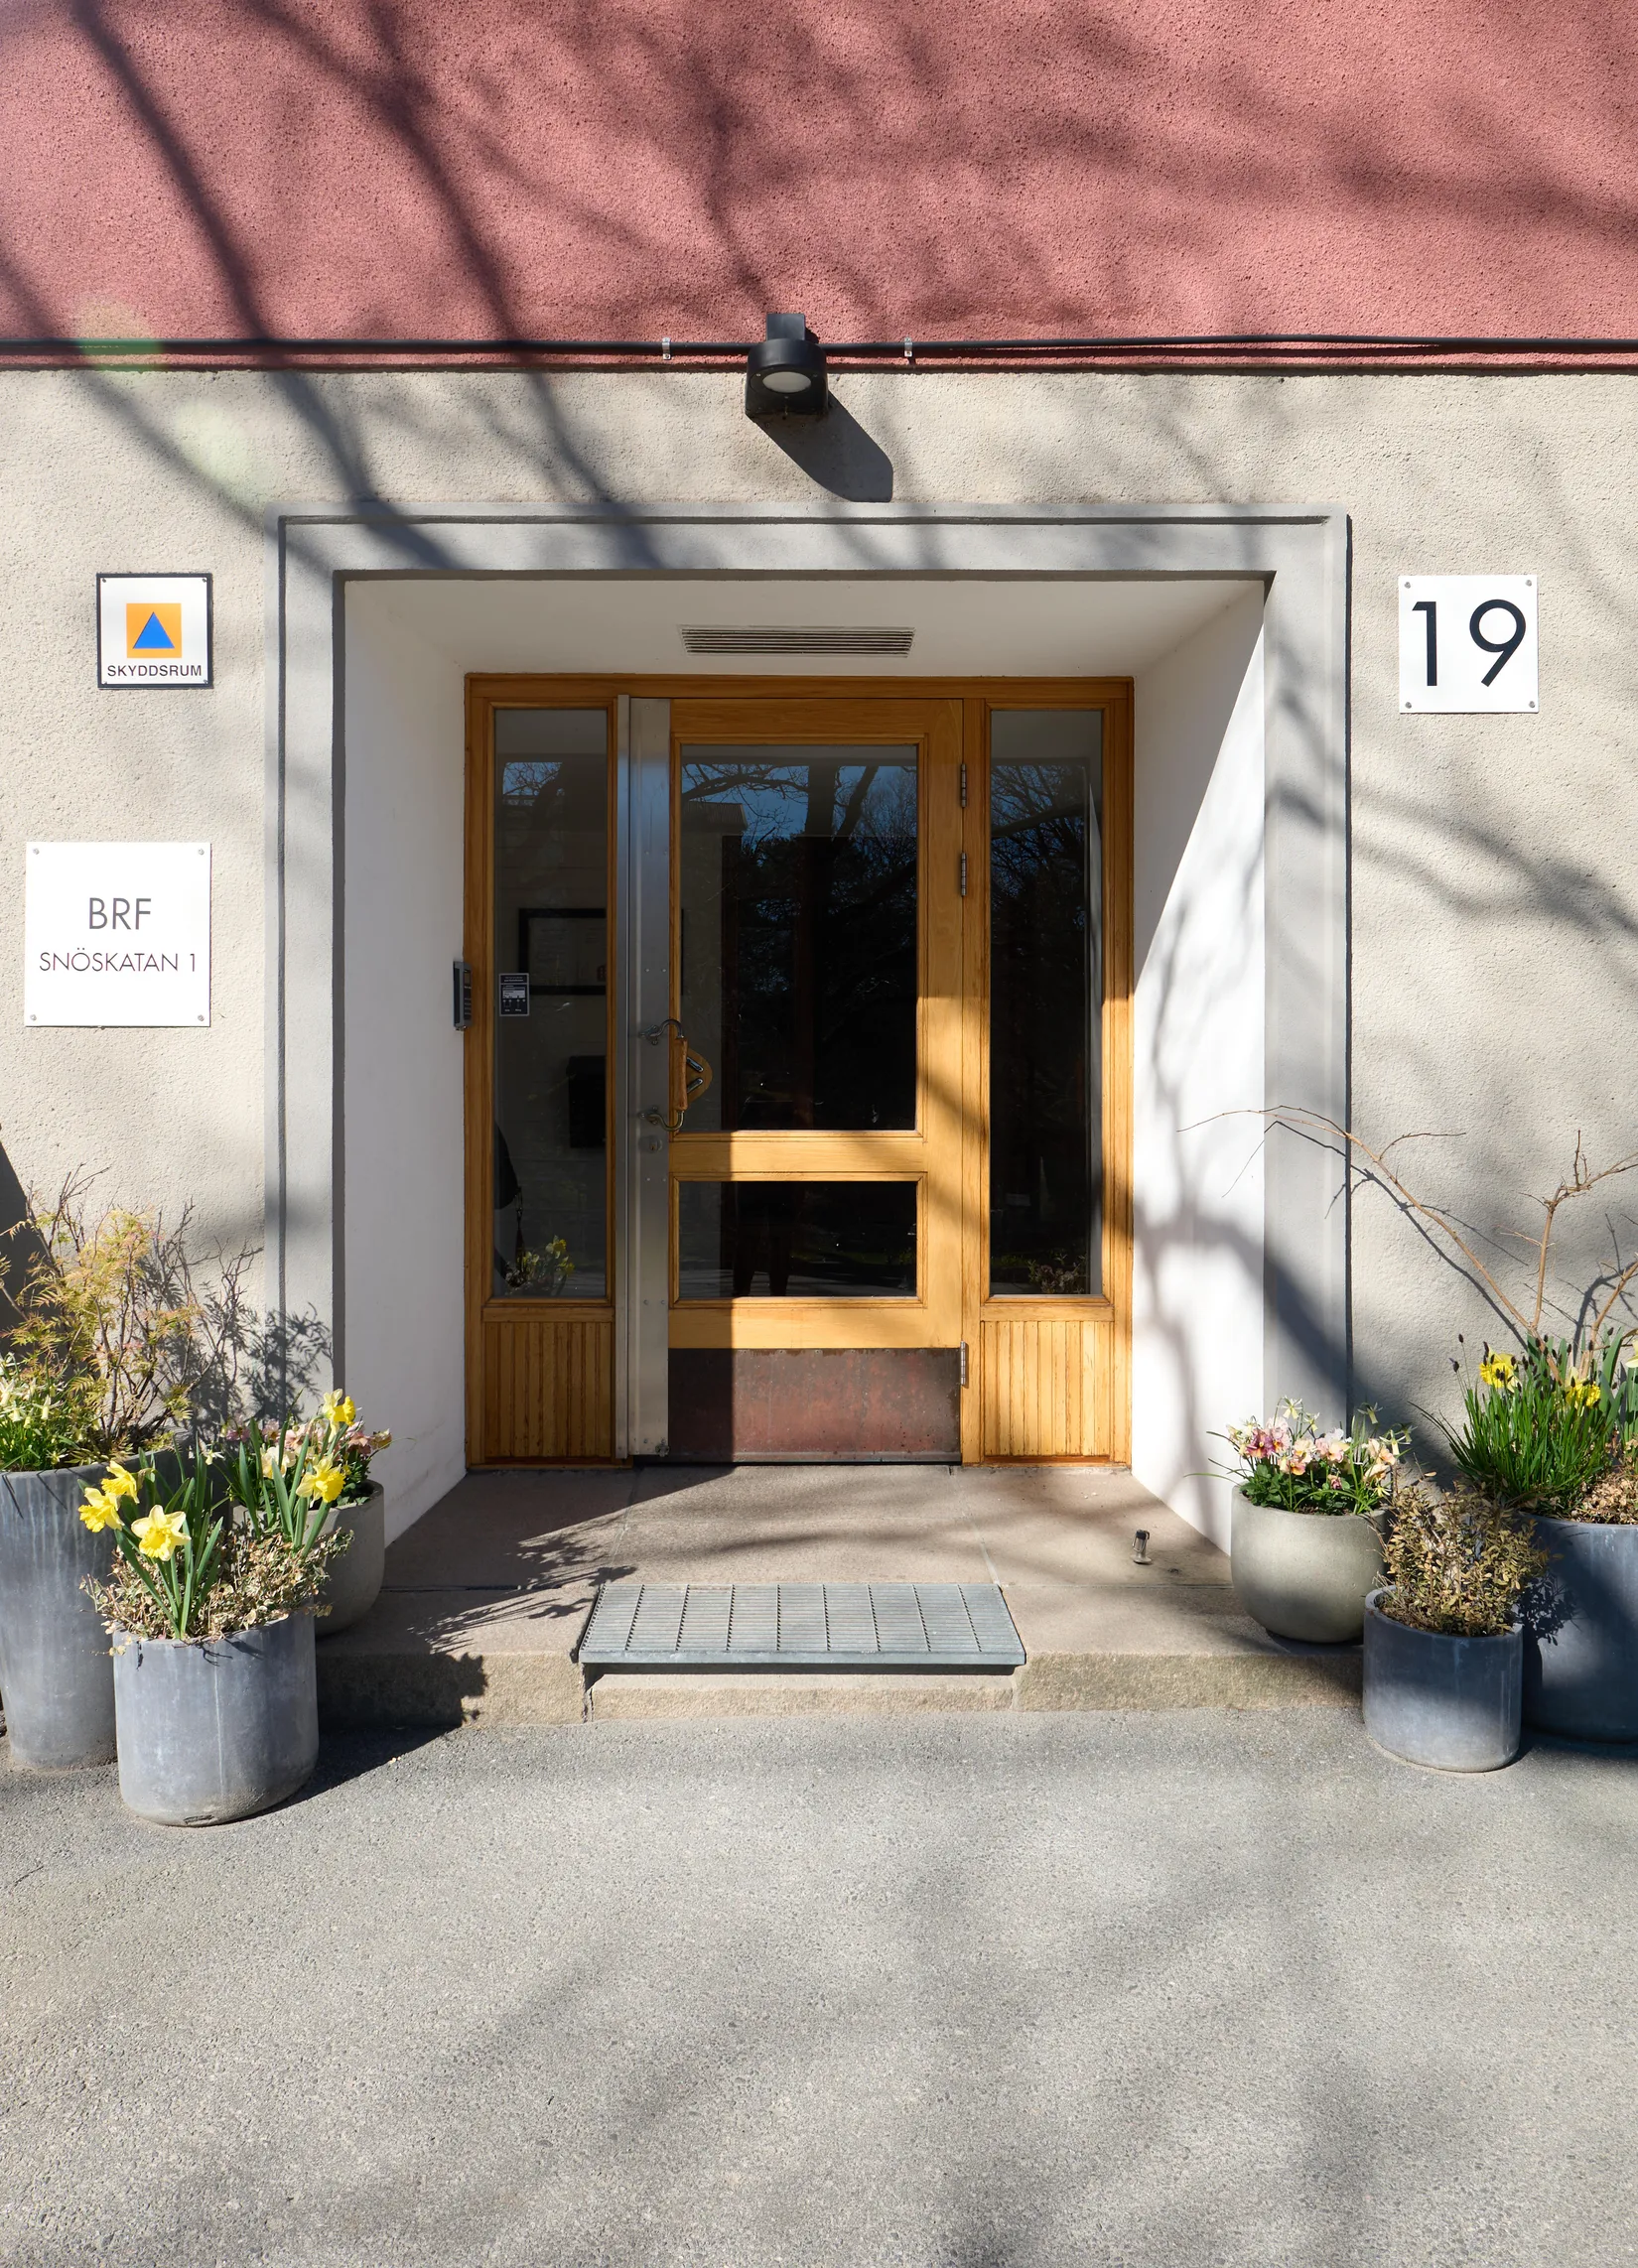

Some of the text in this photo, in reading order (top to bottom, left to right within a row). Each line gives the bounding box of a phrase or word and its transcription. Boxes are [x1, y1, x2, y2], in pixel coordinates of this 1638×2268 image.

[1412, 599, 1527, 688] 19
[107, 664, 203, 677] SKYDDSRUM
[88, 897, 152, 930] BRF
[39, 947, 196, 972] SNÖSKATAN 1
